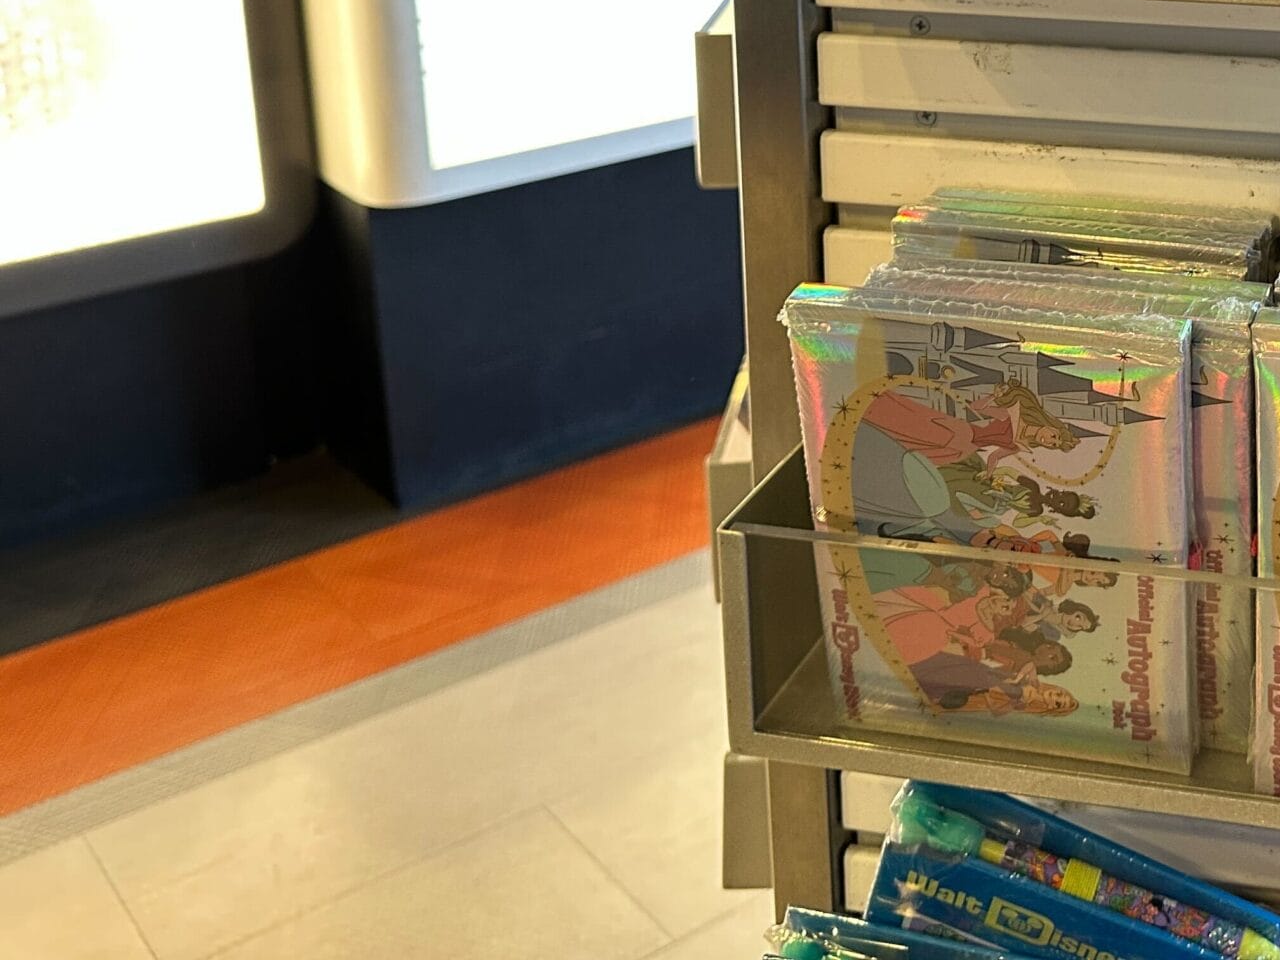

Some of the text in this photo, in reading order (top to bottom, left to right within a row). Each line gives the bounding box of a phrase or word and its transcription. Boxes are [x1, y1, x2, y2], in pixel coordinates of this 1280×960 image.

[1121, 618, 1158, 741] Autograph
[906, 869, 1126, 960] Walt Disne
